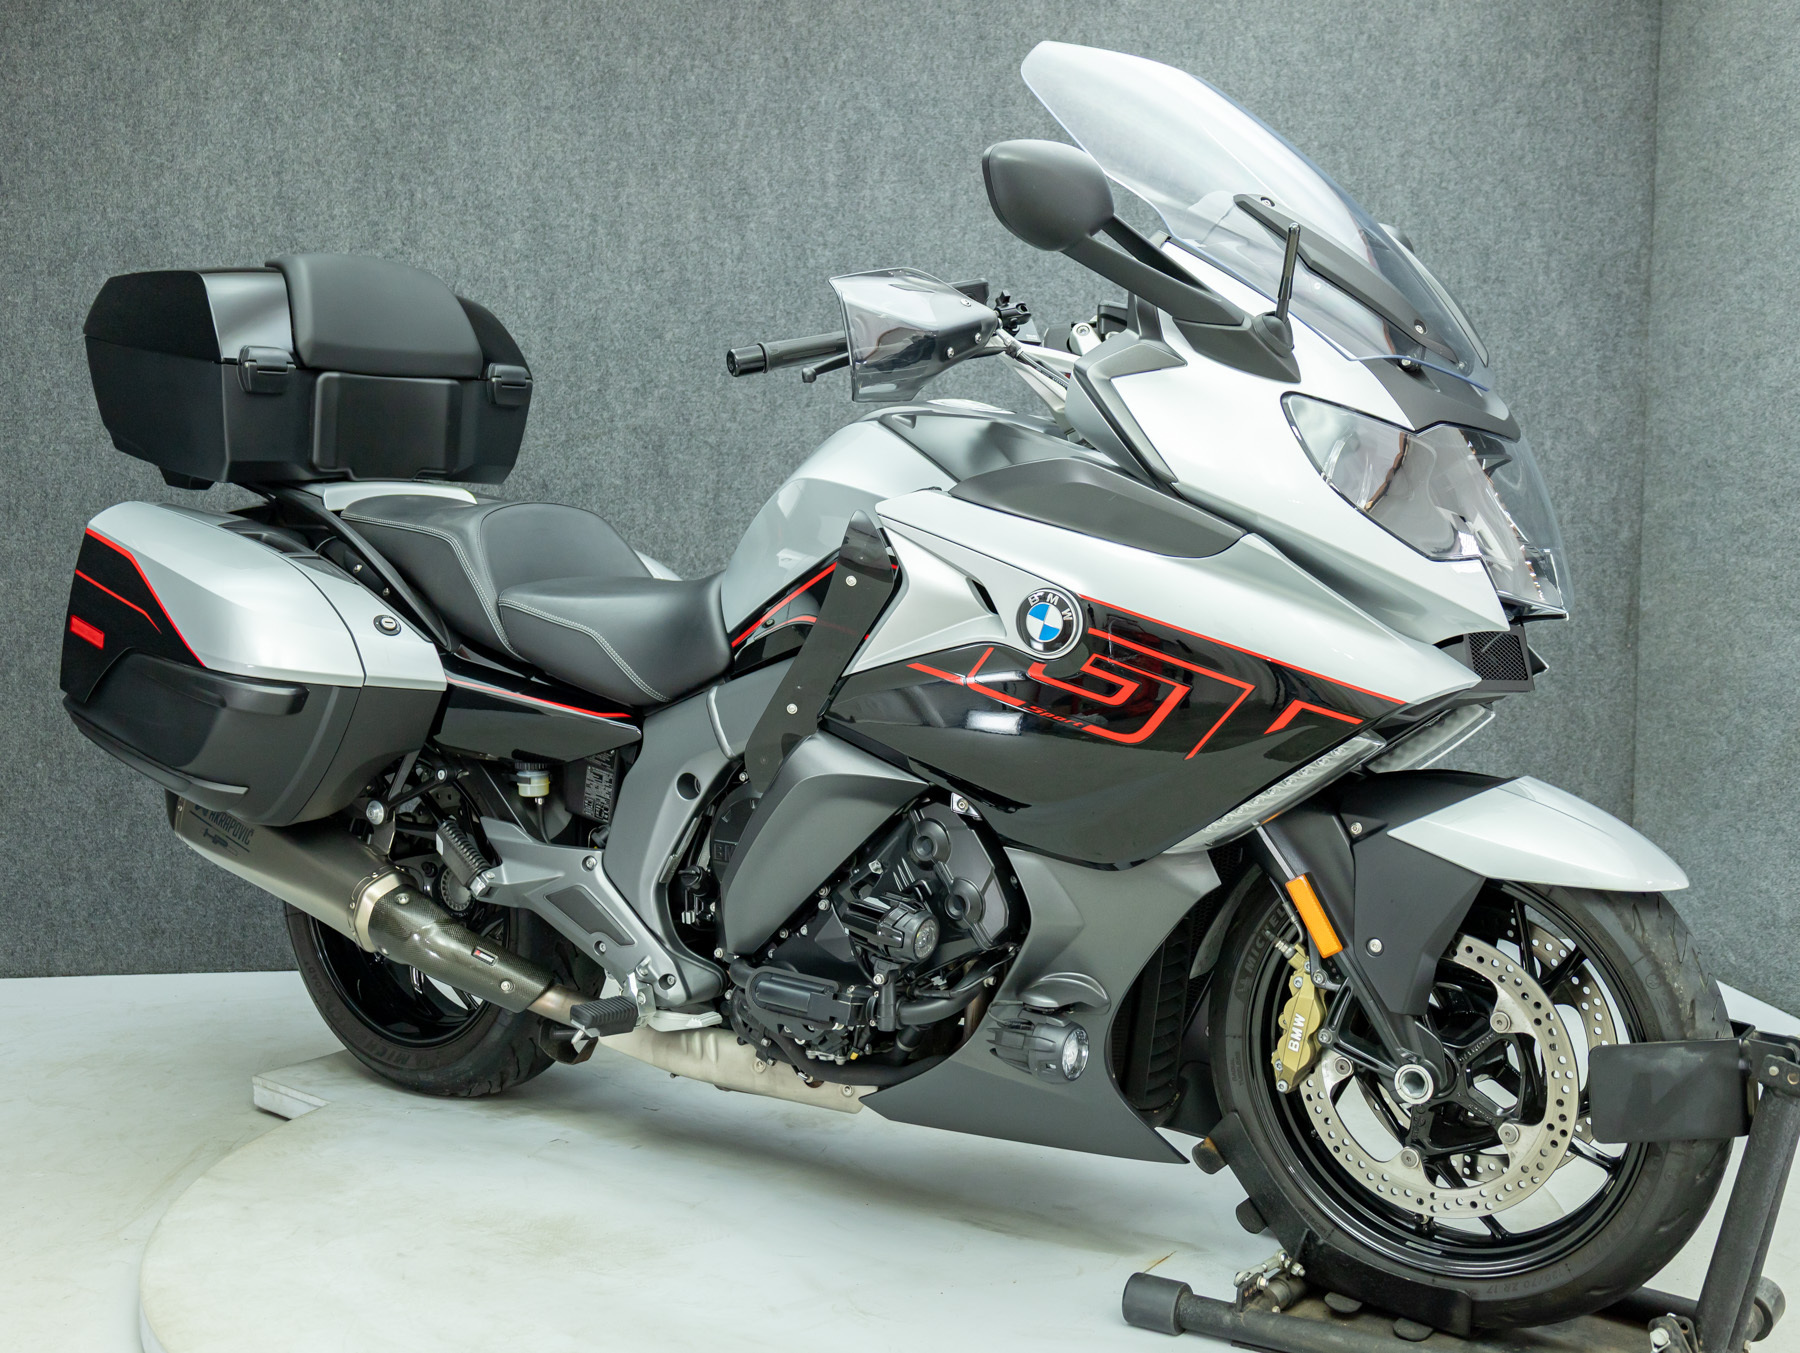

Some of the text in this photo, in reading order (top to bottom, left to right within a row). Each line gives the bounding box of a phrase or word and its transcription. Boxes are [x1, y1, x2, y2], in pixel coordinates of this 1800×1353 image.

[1027, 592, 1073, 621] BMW
[1022, 705, 1084, 727] Sport
[1287, 1012, 1306, 1053] BMW
